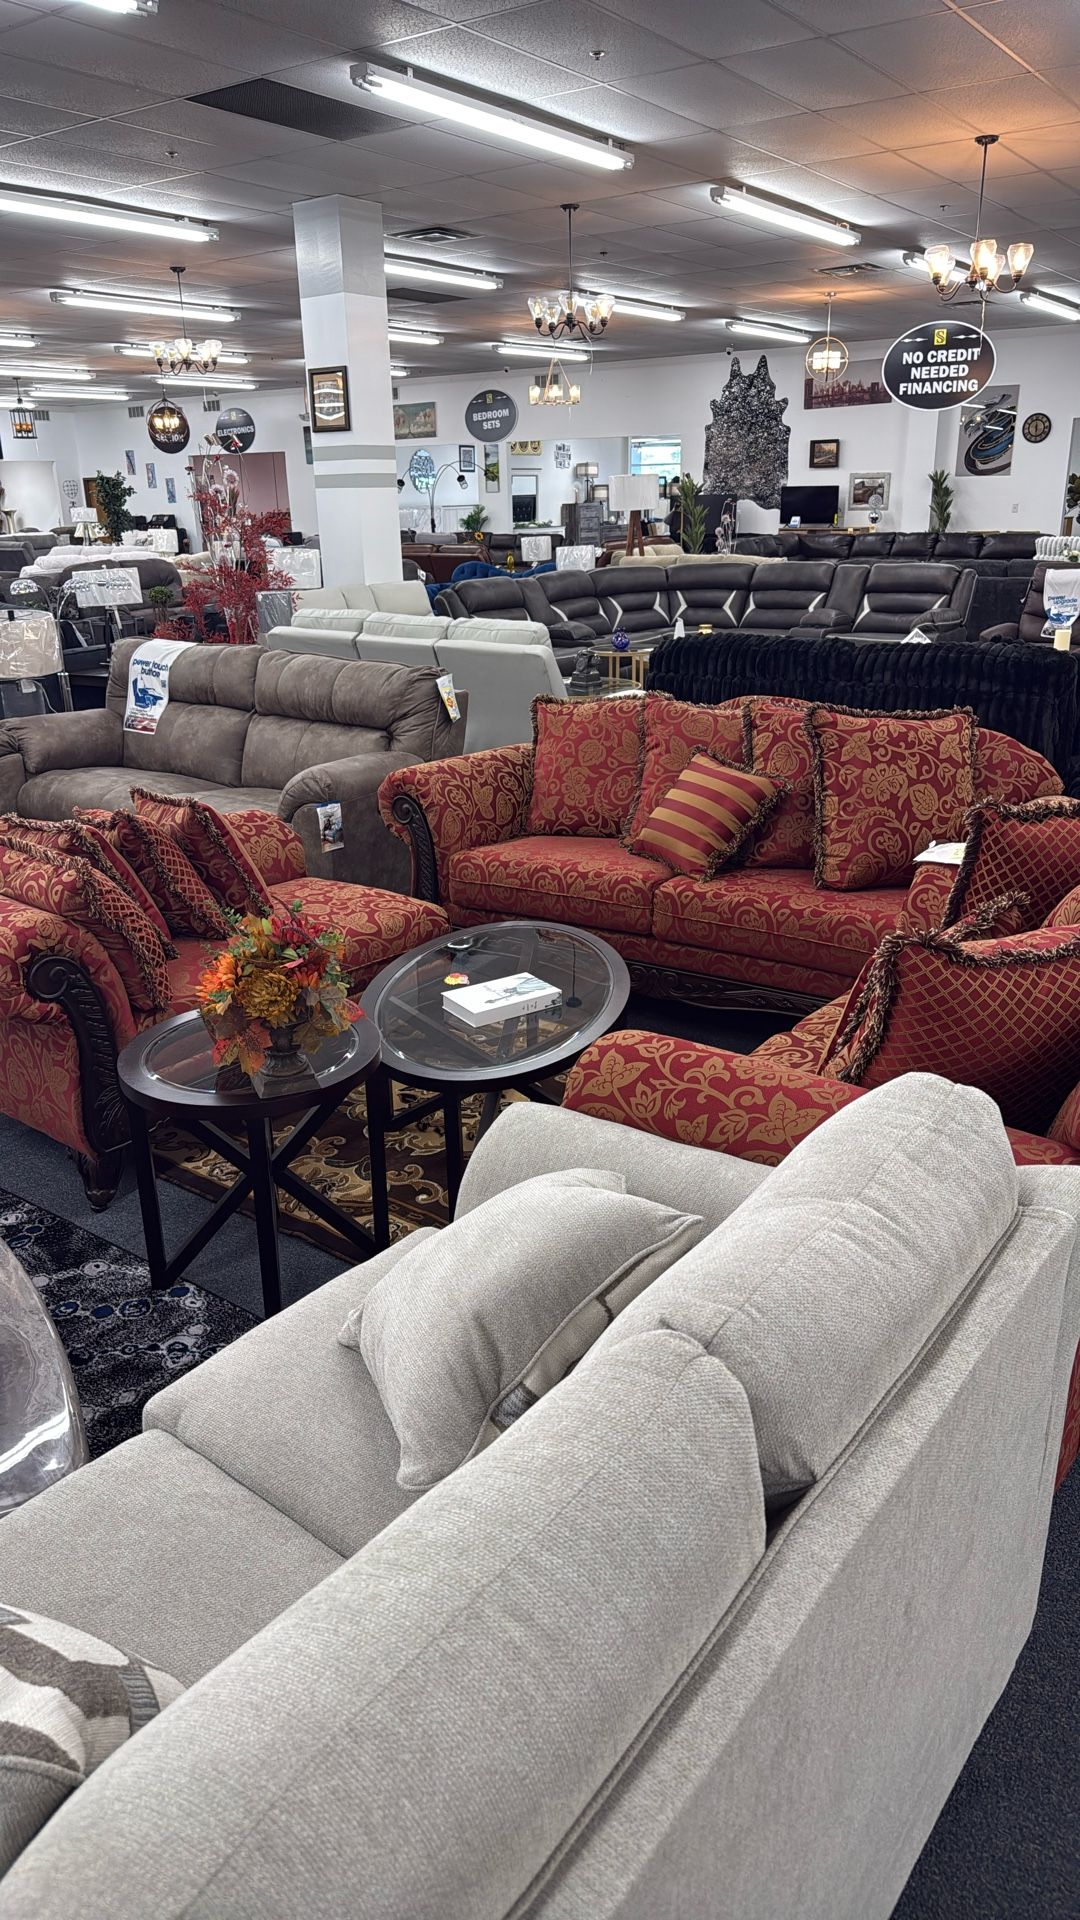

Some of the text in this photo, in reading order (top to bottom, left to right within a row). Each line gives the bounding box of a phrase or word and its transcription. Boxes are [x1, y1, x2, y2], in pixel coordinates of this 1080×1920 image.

[902, 347, 981, 364] NO CREDIT
[911, 365, 969, 379] NEEDED
[899, 379, 978, 395] FINANCING
[473, 409, 509, 421] BEDROOM
[483, 420, 500, 429] SETS
[217, 426, 254, 437] ELECTRONICS
[132, 658, 168, 671] power touch
[141, 667, 160, 678] button
